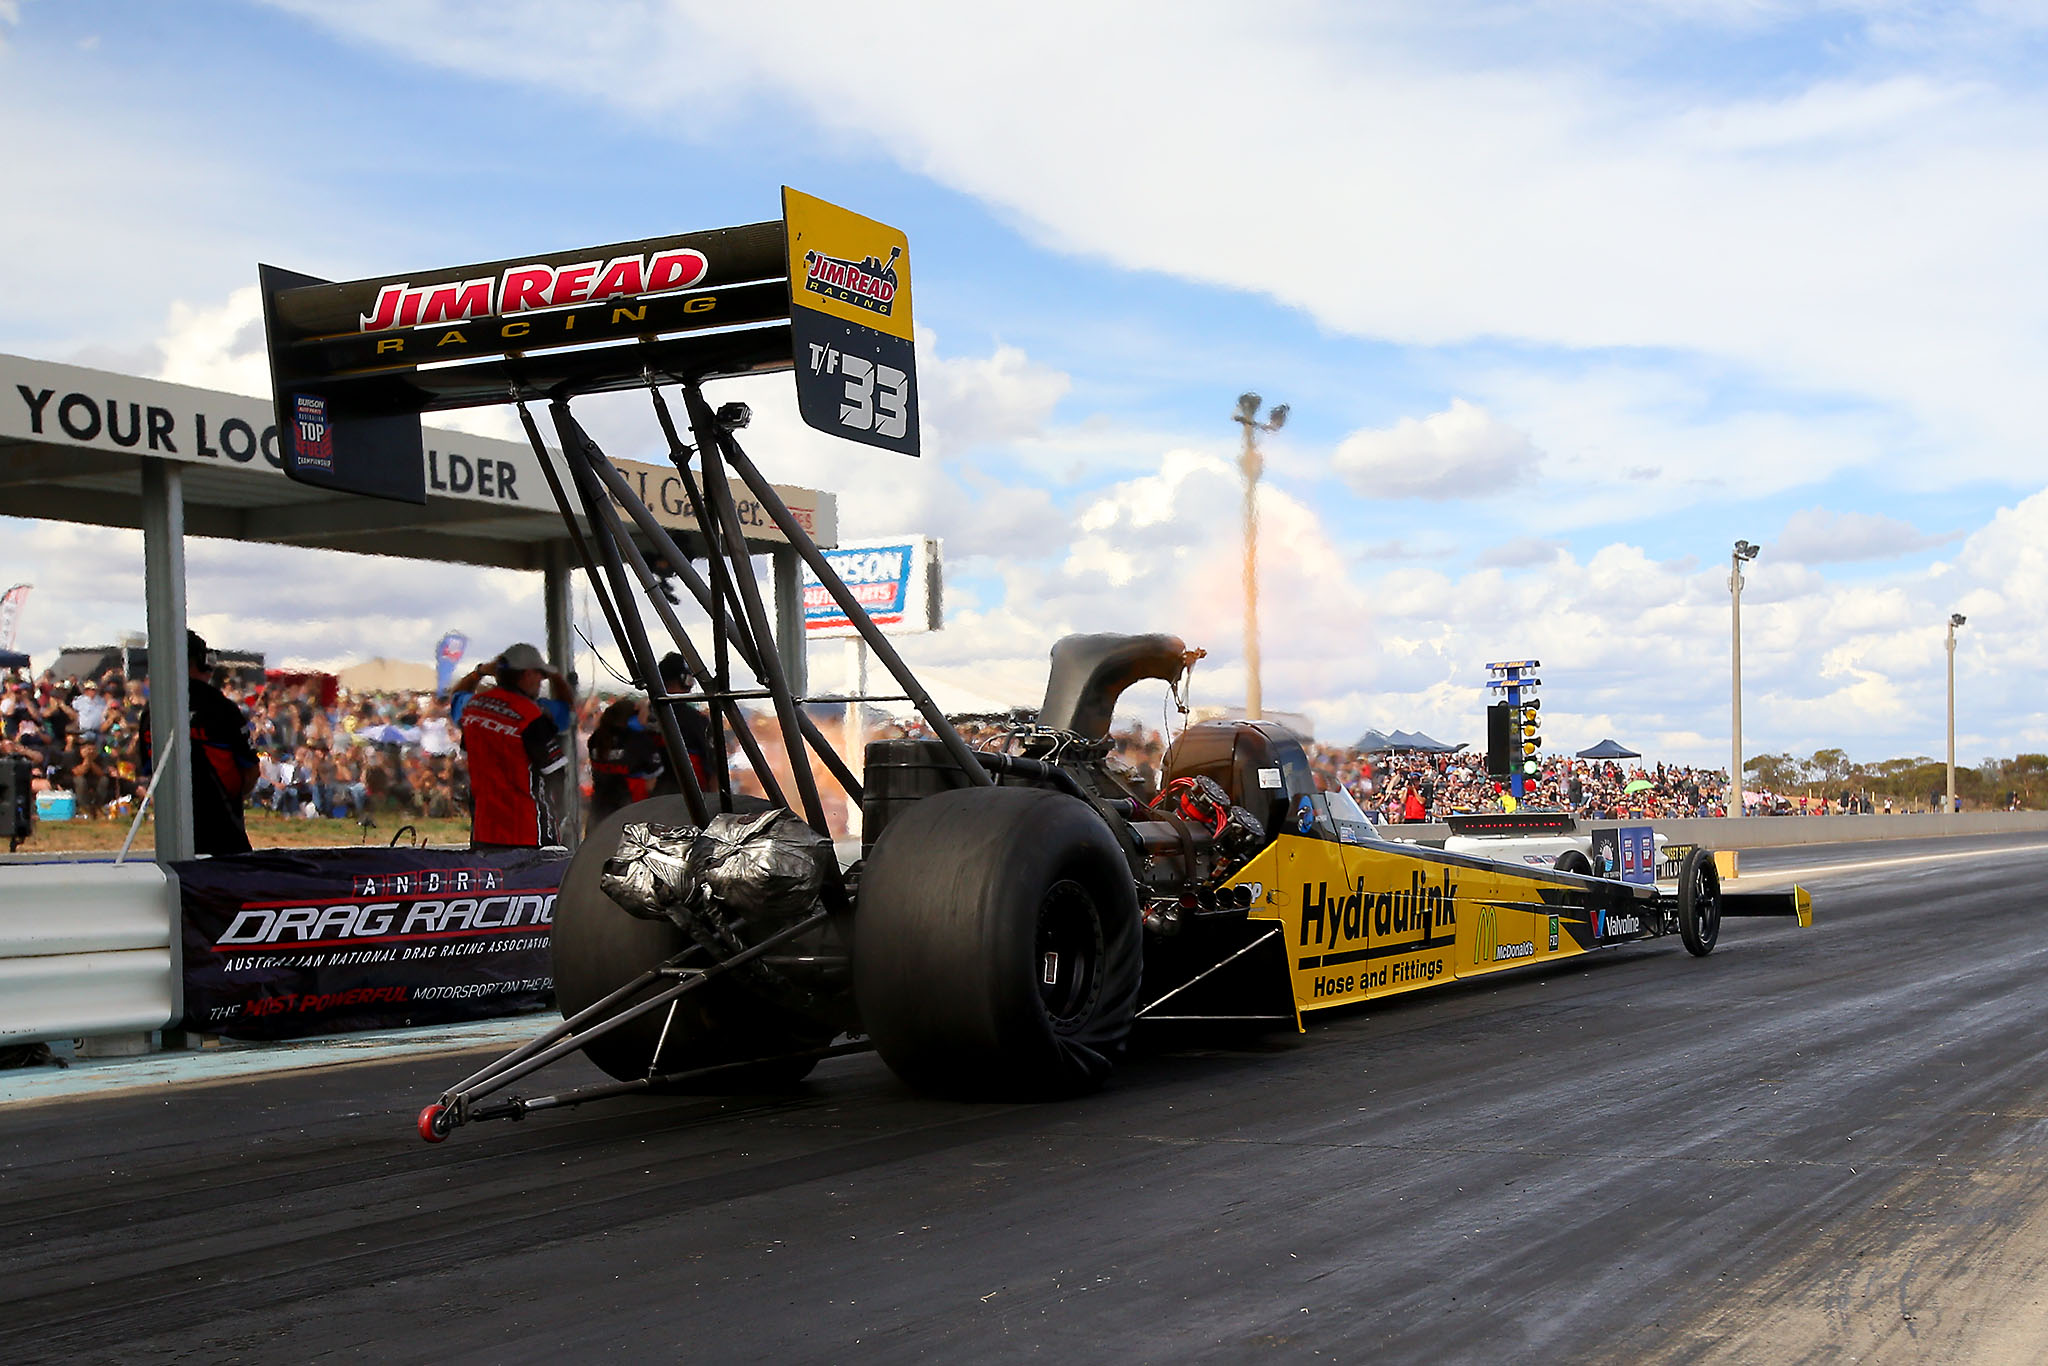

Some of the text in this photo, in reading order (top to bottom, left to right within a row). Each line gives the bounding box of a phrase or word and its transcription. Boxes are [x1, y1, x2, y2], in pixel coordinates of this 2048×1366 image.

[360, 248, 708, 332] JIM READ
[809, 253, 895, 303] JIM READ
[809, 281, 889, 313] RACING
[377, 297, 717, 353] RACING
[809, 342, 909, 440] T/F 33
[16, 384, 519, 500] YOUR LOC LDER
[300, 422, 324, 441] TOP
[661, 477, 764, 527] Gaer.
[363, 872, 496, 896] ANDRA
[216, 903, 400, 945] DRAG
[1300, 867, 1458, 950] Hydraulink
[1606, 914, 1640, 938] Valvoline
[224, 937, 551, 973] AUSTRALIAN NATIONAL DRAG RACING ASSOCIATIO
[1496, 941, 1534, 960] McDonald's
[1314, 958, 1443, 997] Hose and Fittings
[210, 1005, 241, 1020] THE
[243, 993, 299, 1016] MOST
[299, 986, 408, 1013] POWERFUL
[412, 983, 502, 1000] MOTORSPORT
[501, 981, 520, 994] ON
[521, 978, 543, 991] THE
